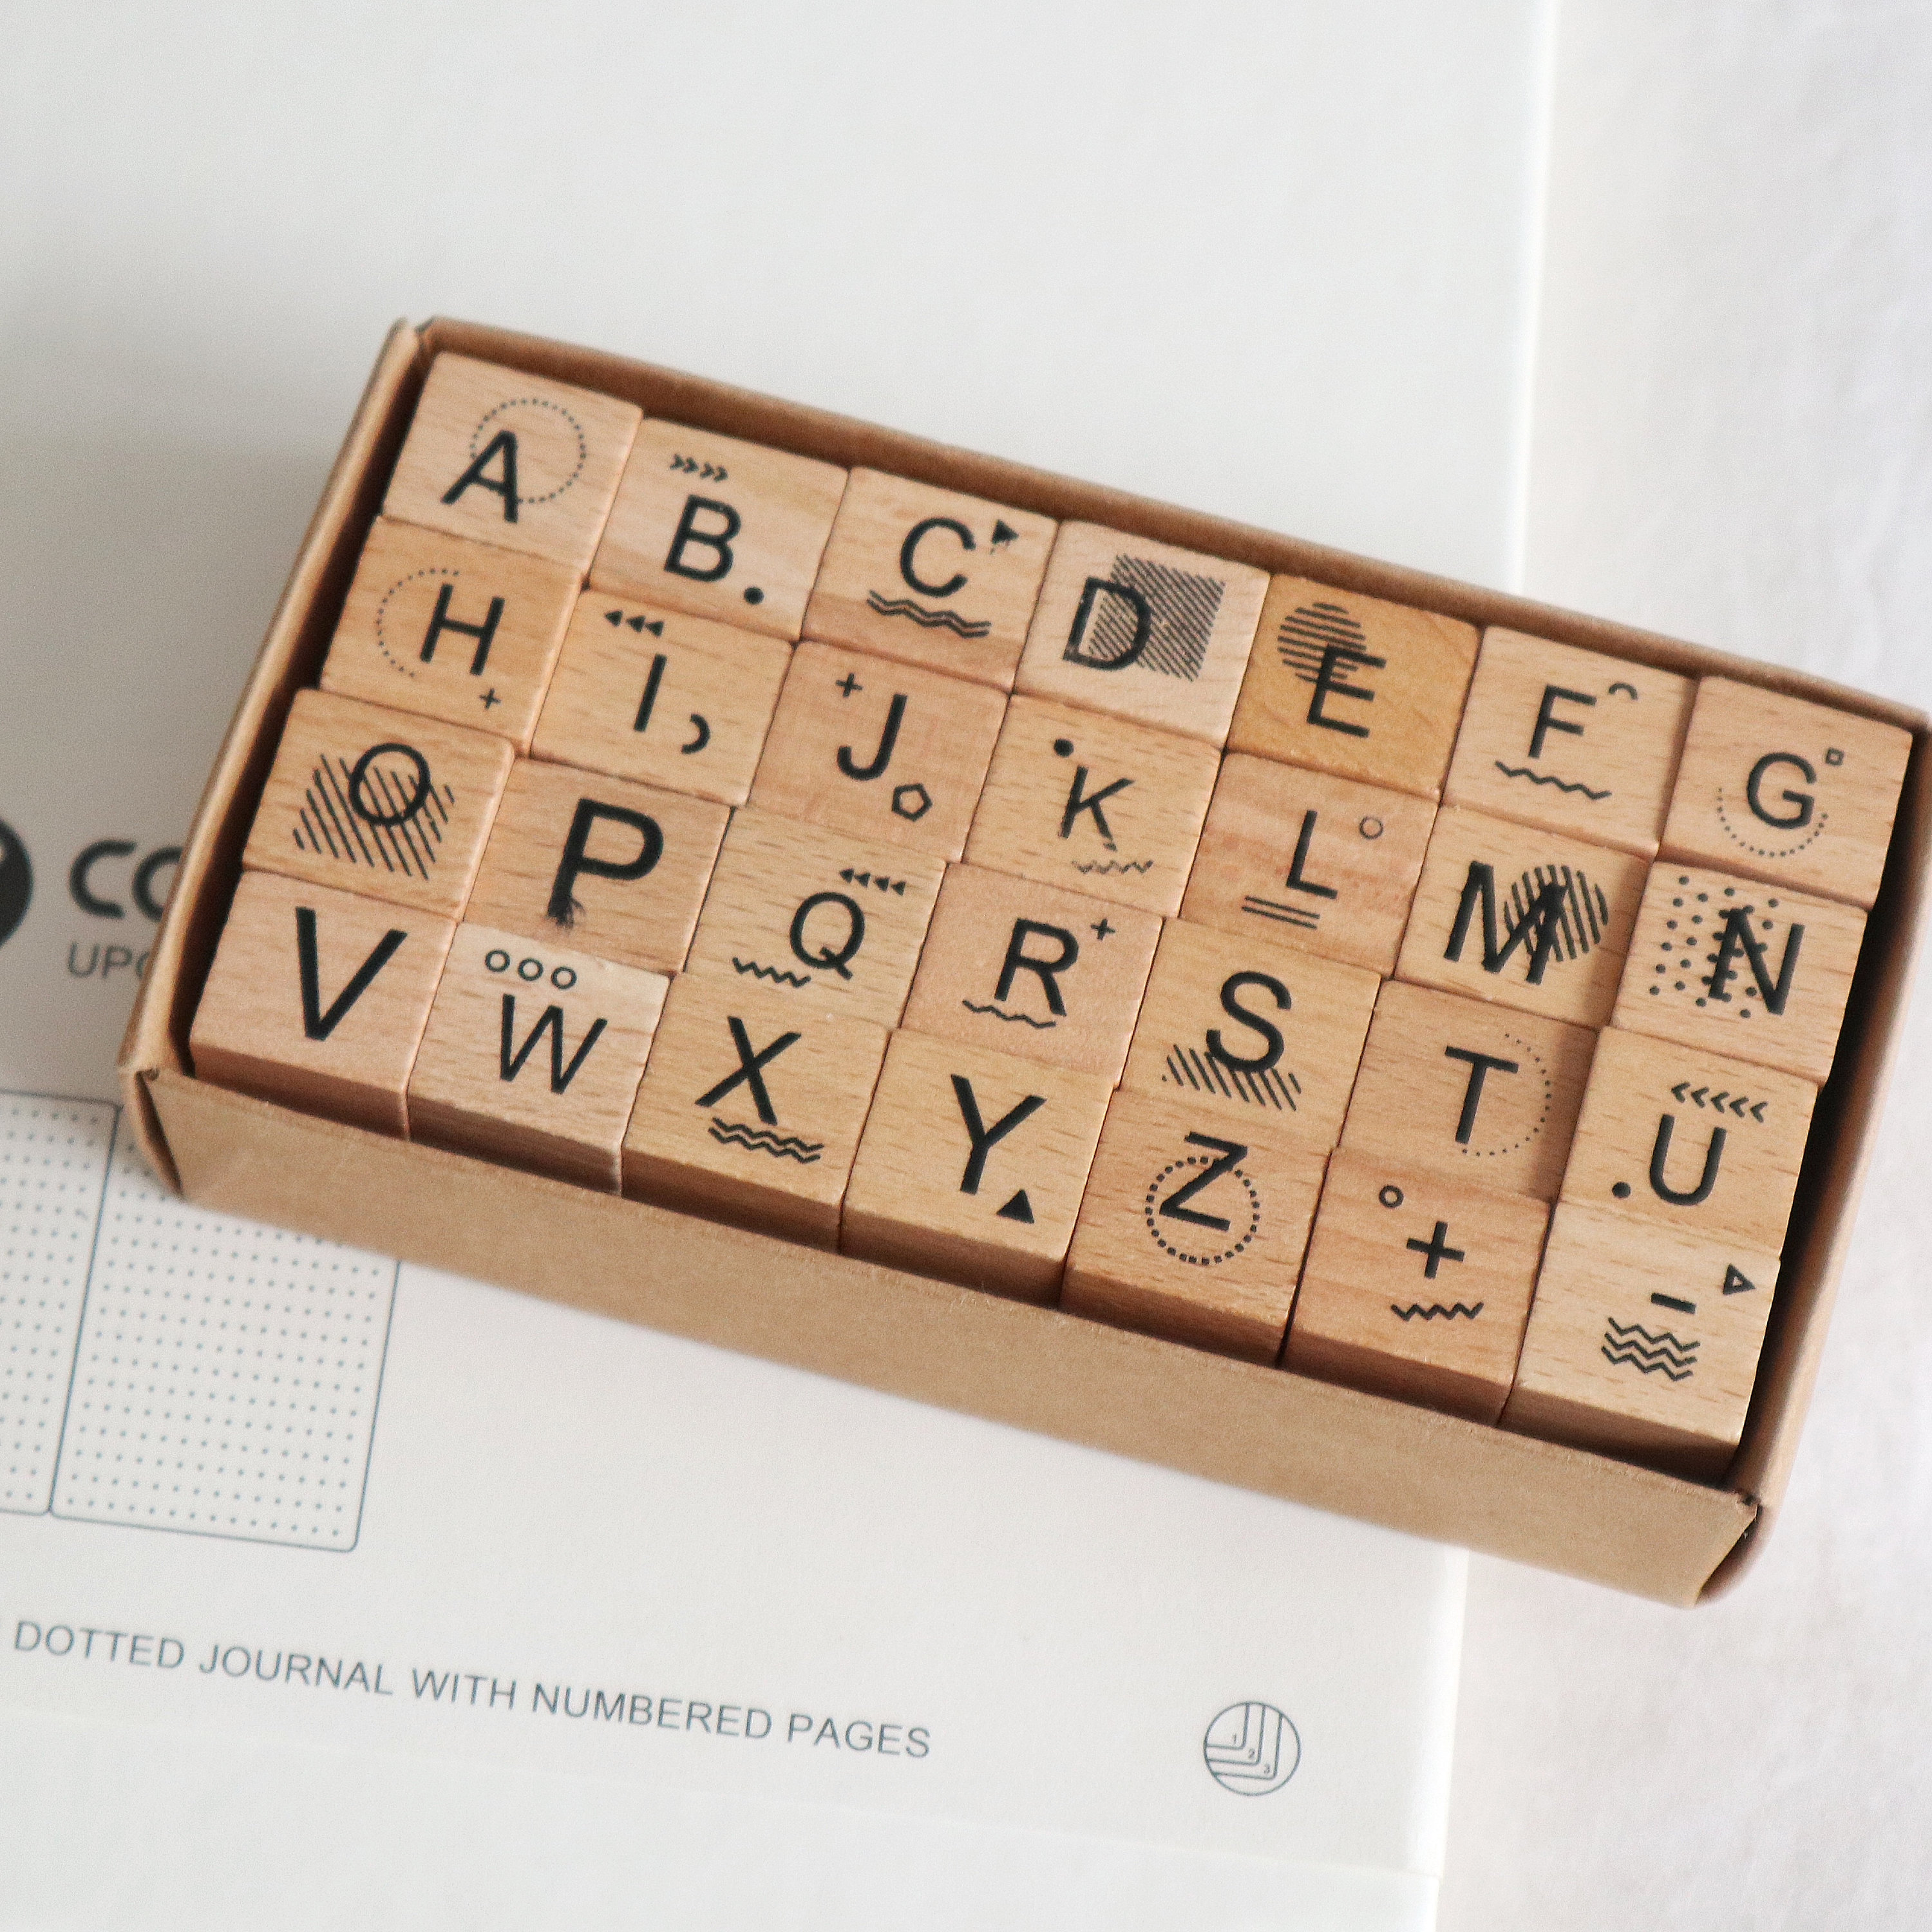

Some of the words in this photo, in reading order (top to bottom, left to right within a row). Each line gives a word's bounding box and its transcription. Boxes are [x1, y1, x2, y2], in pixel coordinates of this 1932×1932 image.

[442, 430, 518, 523] A
[664, 495, 741, 582] B
[900, 518, 976, 598] C
[420, 584, 506, 676] H
[1063, 576, 1151, 670] D
[633, 654, 667, 732] I
[1307, 644, 1385, 737] E
[1528, 685, 1596, 758] F
[837, 694, 907, 781] J
[348, 743, 430, 826] O
[1061, 766, 1133, 840] K
[1746, 752, 1815, 829] G
[547, 799, 663, 924] P
[1285, 810, 1338, 900] L
[790, 891, 866, 980] Q
[994, 918, 1079, 1016] R
[1444, 861, 1567, 985] M
[1708, 908, 1804, 1016] N
[296, 907, 407, 1041] V
[500, 994, 608, 1095] W
[1205, 971, 1292, 1074] S
[695, 1016, 802, 1126] X
[1444, 1045, 1519, 1144] T
[951, 1074, 1046, 1195] Y
[1649, 1114, 1727, 1206] U
[1159, 1132, 1248, 1231] Z
[14, 1620, 185, 1669] DOTTED
[199, 1644, 393, 1696] JOURNAL
[412, 1668, 516, 1710] WITH
[531, 1683, 773, 1740] NUMBERED
[786, 1713, 931, 1759] PAGES
